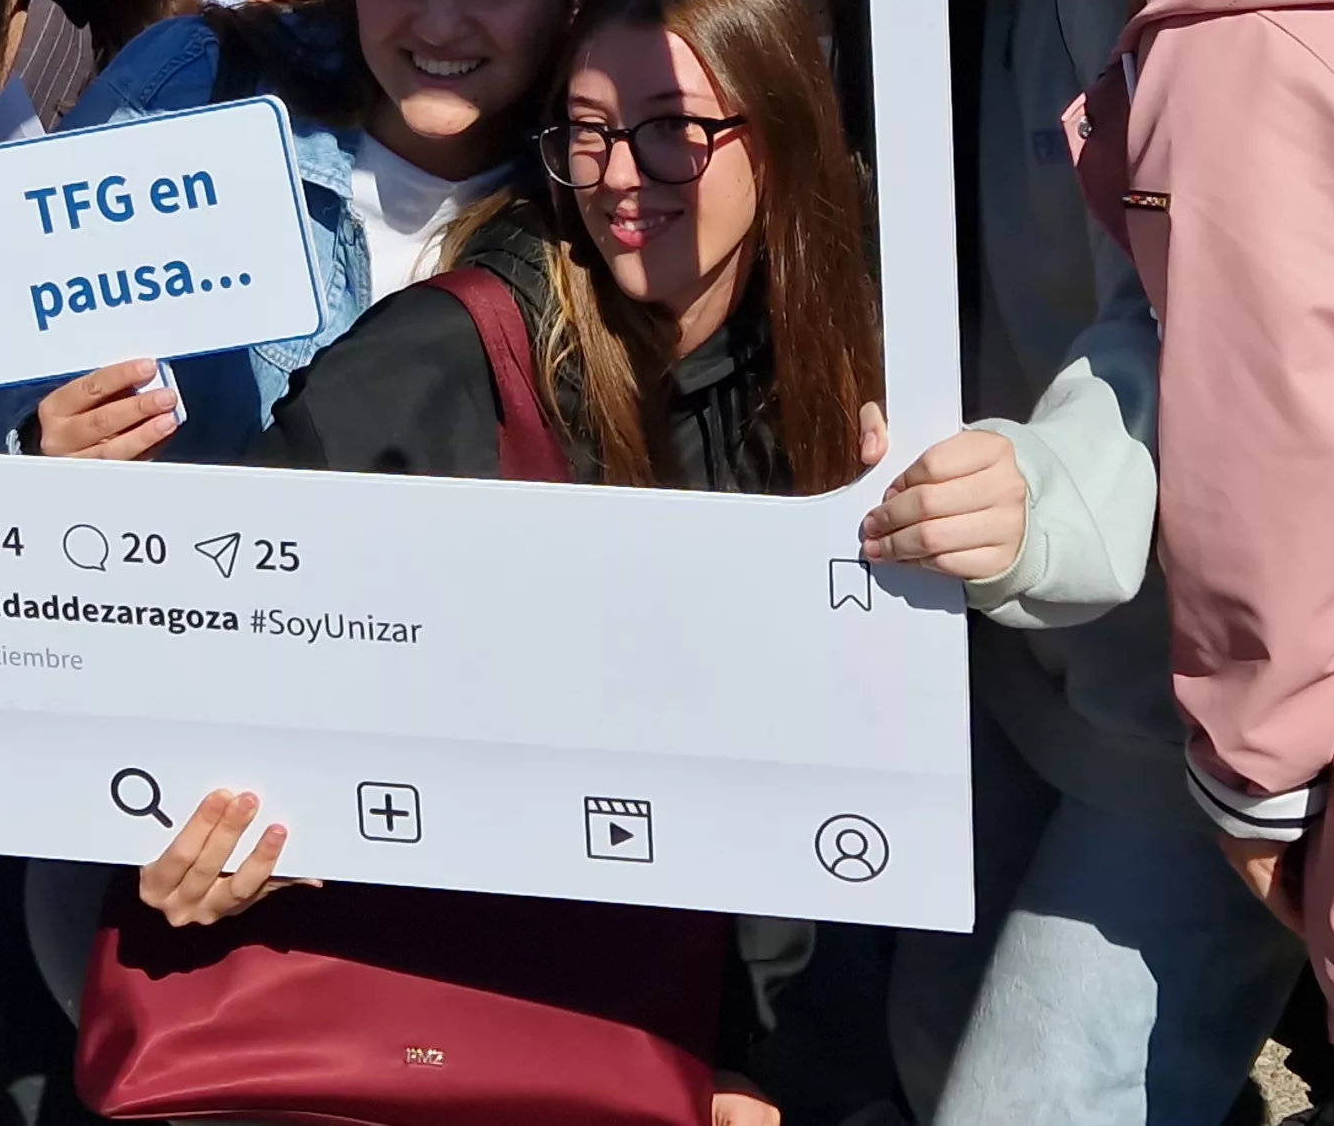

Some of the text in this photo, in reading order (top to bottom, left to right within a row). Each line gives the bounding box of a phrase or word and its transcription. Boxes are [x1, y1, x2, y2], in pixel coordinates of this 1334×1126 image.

[24, 171, 218, 234] TFG en
[30, 260, 252, 331] pausa...
[121, 532, 167, 564] 20
[254, 539, 301, 572] 25
[251, 609, 422, 644] #SoyUnizar
